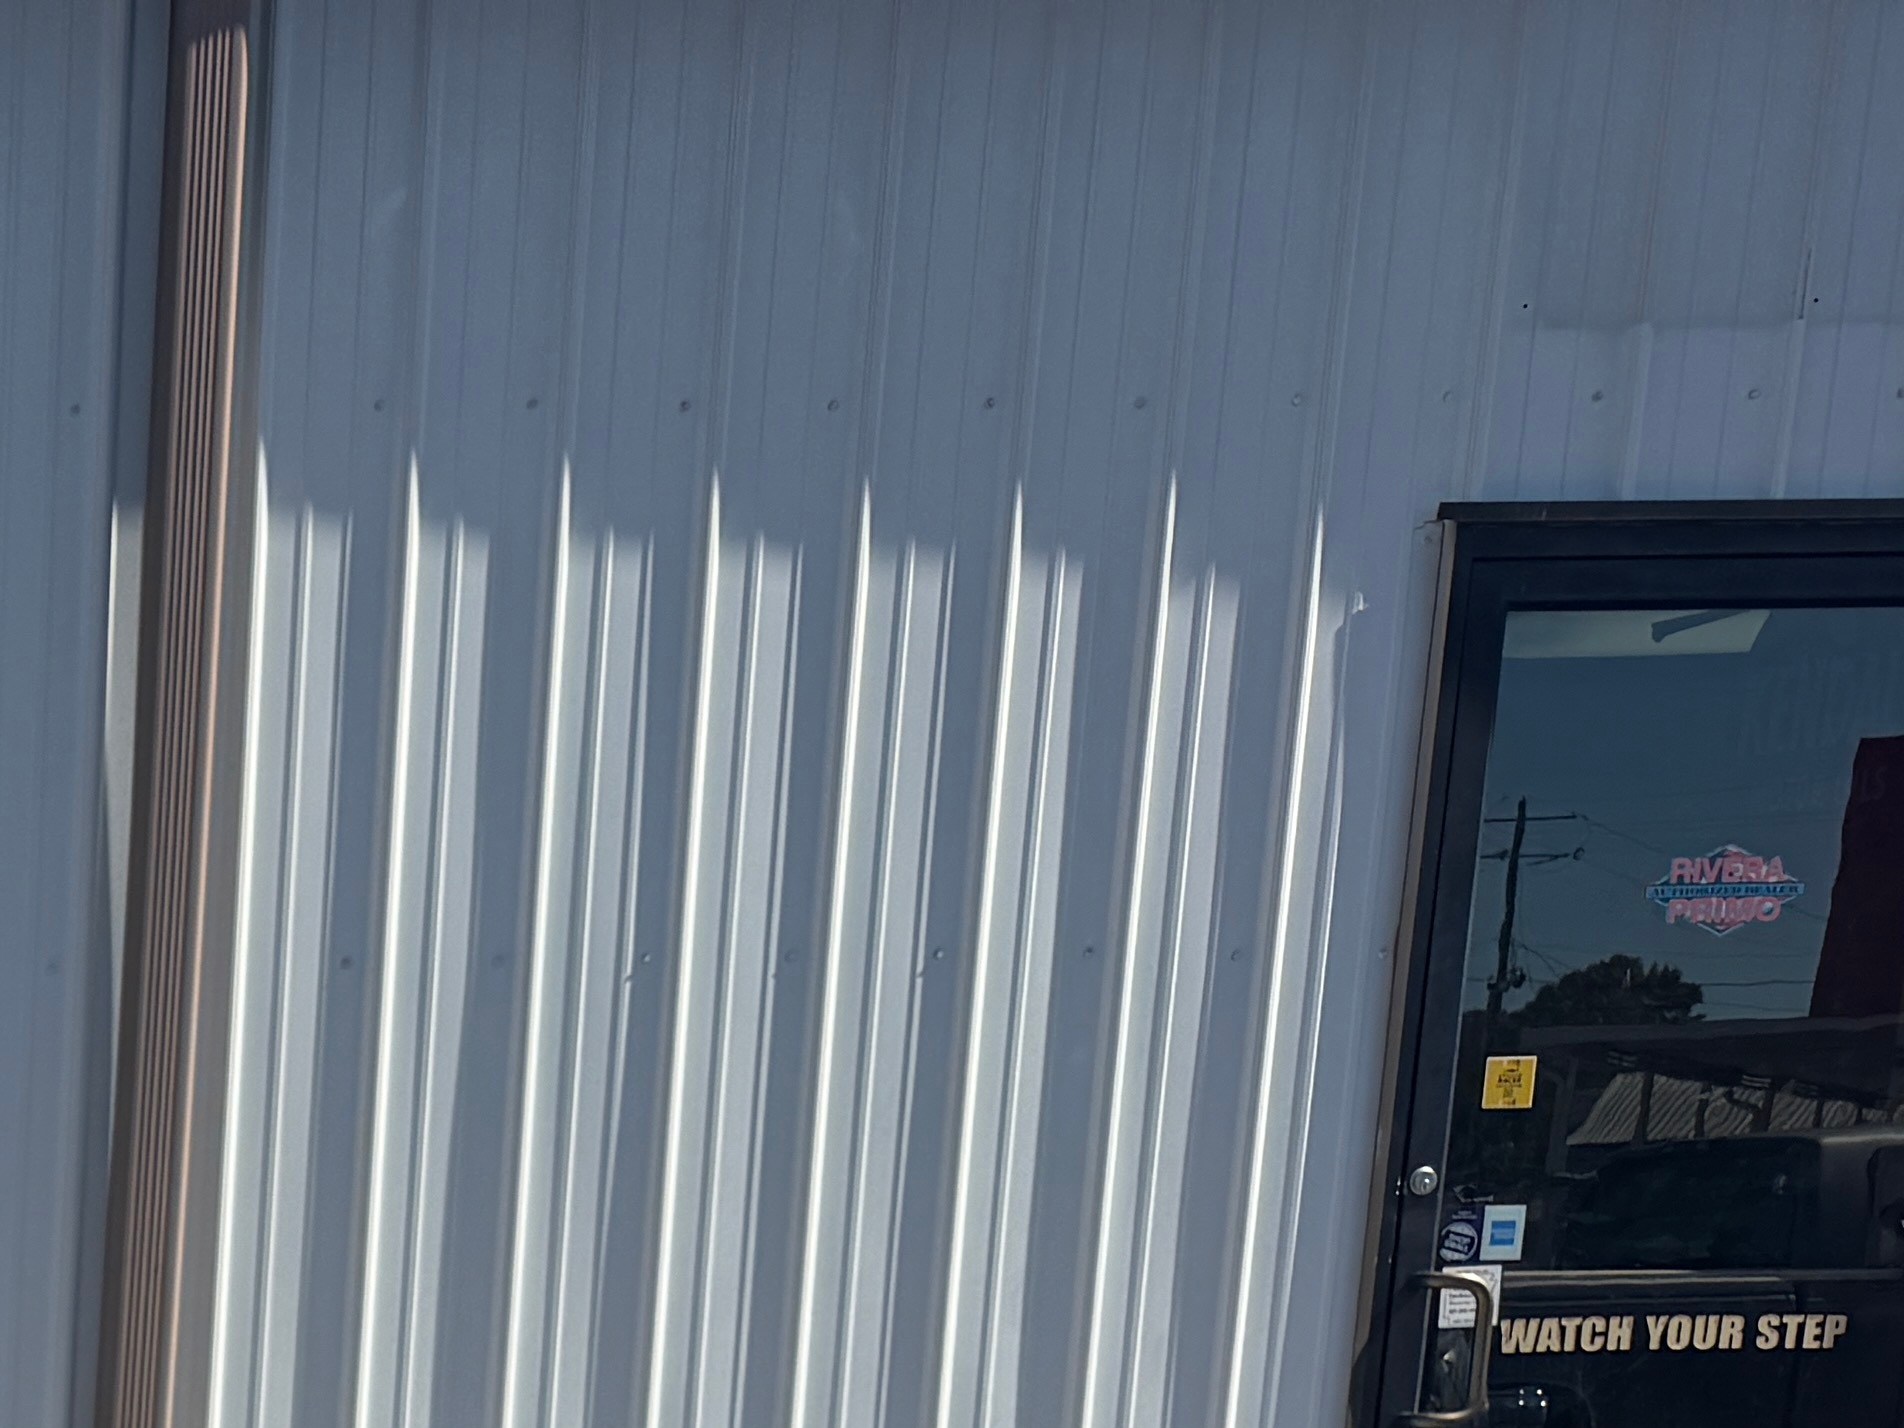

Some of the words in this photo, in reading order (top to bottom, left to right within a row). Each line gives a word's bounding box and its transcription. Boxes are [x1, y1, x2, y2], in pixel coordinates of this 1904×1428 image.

[1669, 856, 1786, 884] RIVERA
[1500, 1316, 1634, 1354] WATCH
[1646, 1314, 1745, 1350] YOUR
[1756, 1314, 1848, 1349] STEP
